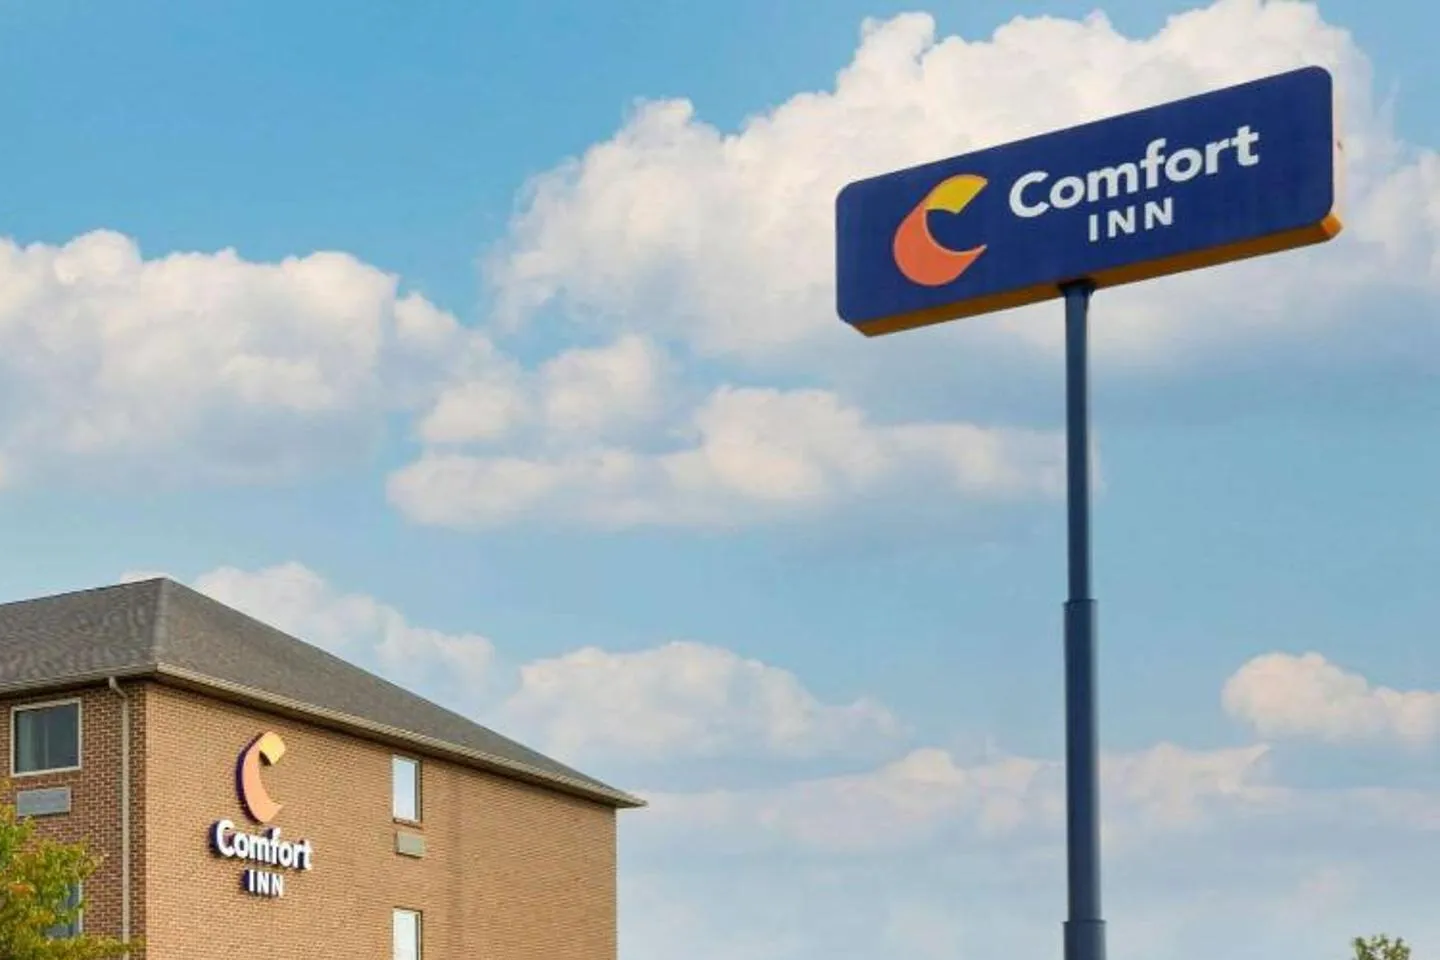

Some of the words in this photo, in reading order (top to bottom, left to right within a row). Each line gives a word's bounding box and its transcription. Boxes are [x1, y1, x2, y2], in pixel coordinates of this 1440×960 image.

[1009, 125, 1260, 218] Comfort
[1089, 197, 1174, 242] INN
[214, 819, 312, 870] Comfort
[247, 869, 284, 896] INN
